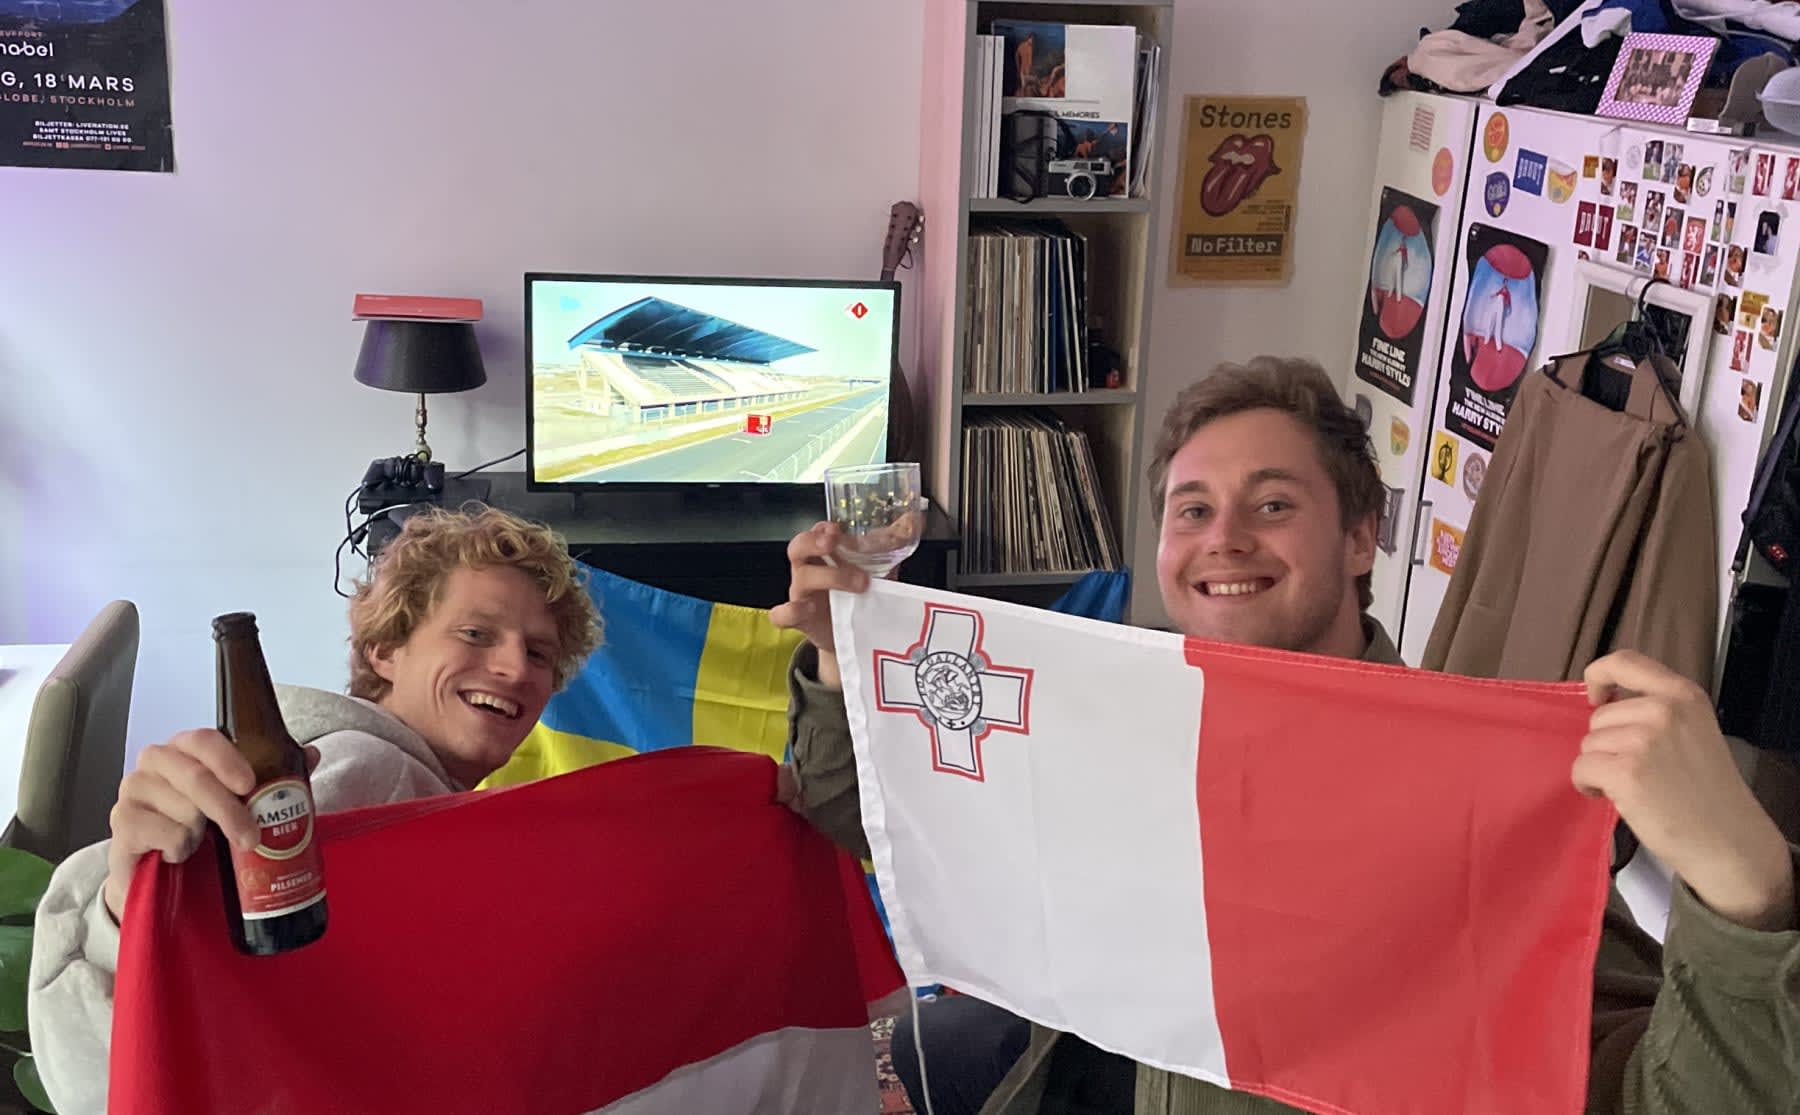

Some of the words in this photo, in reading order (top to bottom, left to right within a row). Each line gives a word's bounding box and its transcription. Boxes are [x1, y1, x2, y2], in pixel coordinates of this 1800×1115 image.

[33, 72, 57, 88] 18
[68, 74, 135, 92] MARS
[50, 95, 135, 107] STOCKHOLM
[1200, 104, 1292, 129] Stones
[1452, 401, 1484, 427] HARRY
[1483, 417, 1502, 436] STY
[257, 801, 306, 825] AMSTEL
[272, 821, 298, 837] BIER
